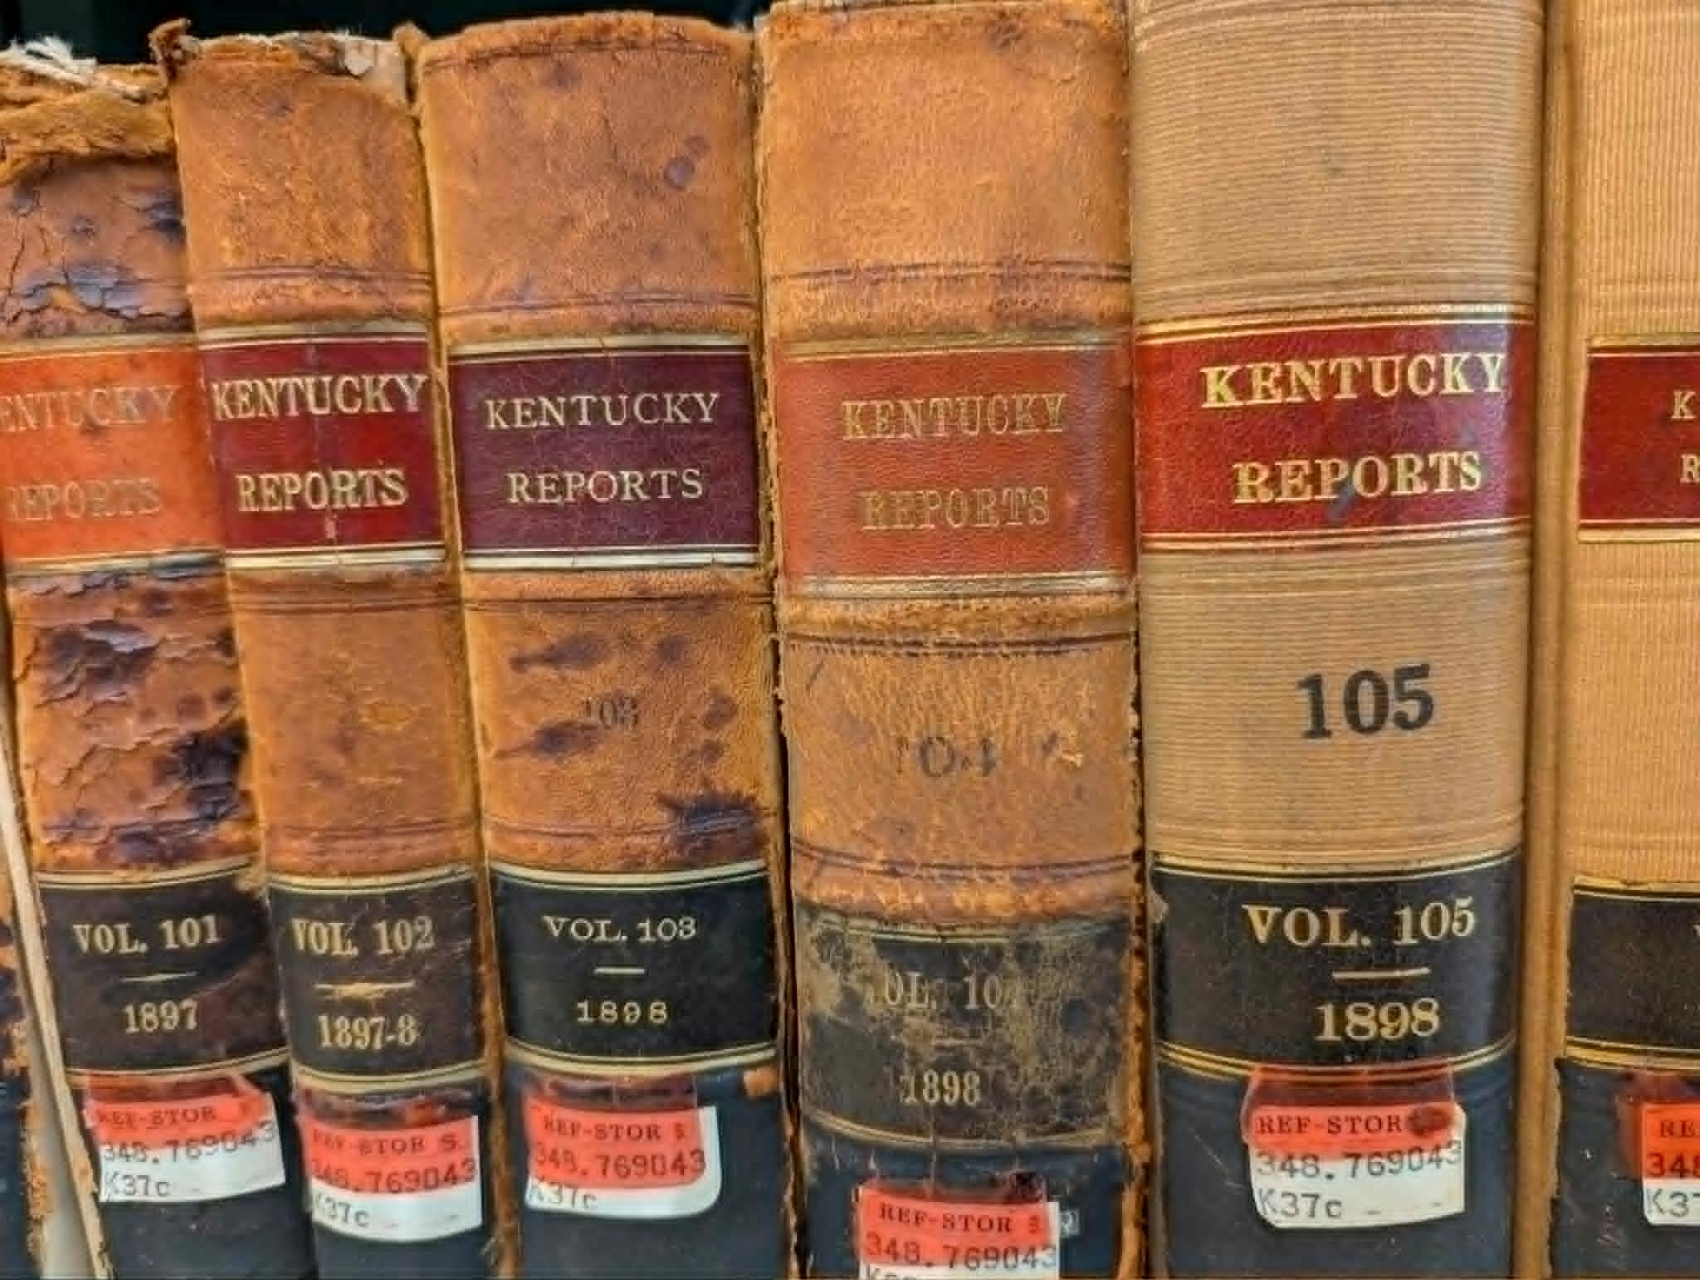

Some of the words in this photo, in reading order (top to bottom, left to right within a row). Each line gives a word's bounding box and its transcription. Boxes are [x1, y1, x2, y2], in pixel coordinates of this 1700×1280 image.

[212, 374, 428, 421] KENTUCKY
[1201, 352, 1507, 409] KENTUCKY
[485, 391, 720, 430] KENTUCKY
[842, 392, 1068, 440] KENTUCKY
[236, 468, 408, 512] REPORTS
[508, 468, 702, 504] REPORTS
[1233, 450, 1483, 504] REPORTS
[860, 485, 1052, 531] REPORTS
[1297, 663, 1435, 740] 105
[73, 922, 148, 954] VOL.
[160, 914, 221, 949] 101
[291, 917, 359, 956] VOL.
[372, 915, 436, 956] 102
[541, 915, 628, 943] VOL.
[1241, 904, 1371, 948] VOL.
[1394, 896, 1476, 946] 105
[124, 998, 199, 1034] 1897
[318, 1013, 422, 1050] 1897-8
[576, 999, 668, 1025] 1898
[1314, 997, 1441, 1042] 1898
[900, 1067, 981, 1107] 1898
[543, 1114, 662, 1140] REF-STOR
[1254, 1114, 1402, 1135] REF-STOR
[535, 1142, 706, 1179] 348.769043
[1256, 1139, 1462, 1179] 348.769043
[878, 1201, 1011, 1233] REF-STOR
[1258, 1187, 1342, 1218] K37c
[865, 1230, 1057, 1270] 348.769043
